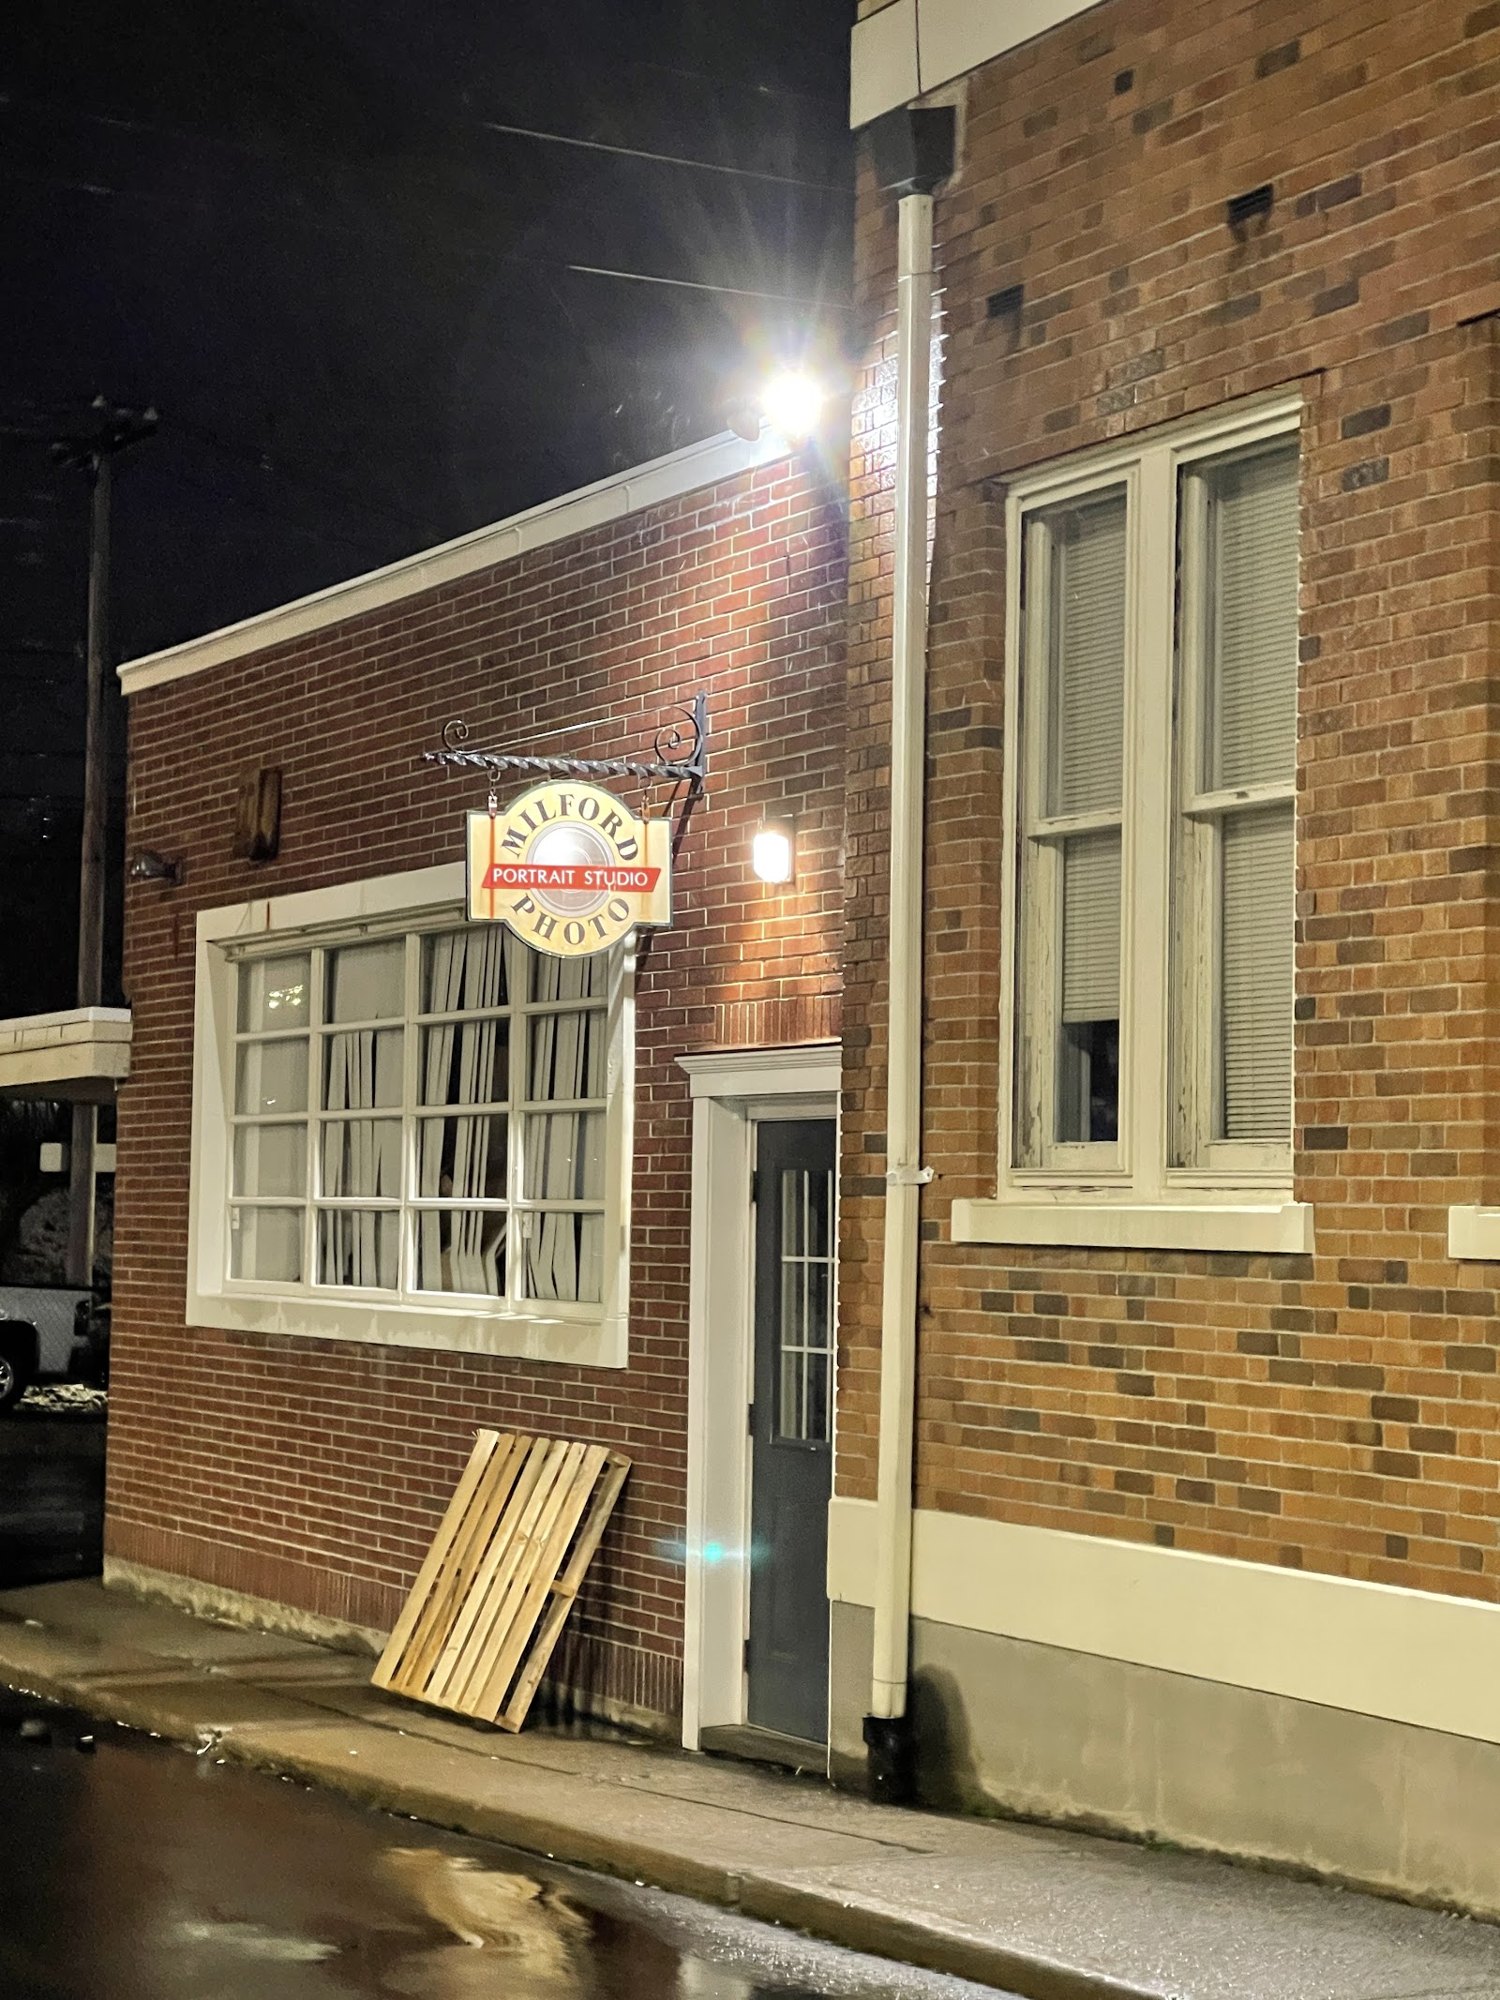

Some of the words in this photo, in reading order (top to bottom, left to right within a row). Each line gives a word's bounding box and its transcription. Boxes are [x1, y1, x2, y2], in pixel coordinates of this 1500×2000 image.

[501, 793, 639, 862] MILFORD
[493, 868, 576, 884] PORTRAIT
[584, 870, 648, 886] STUDIO
[510, 893, 630, 945] PHOTO
